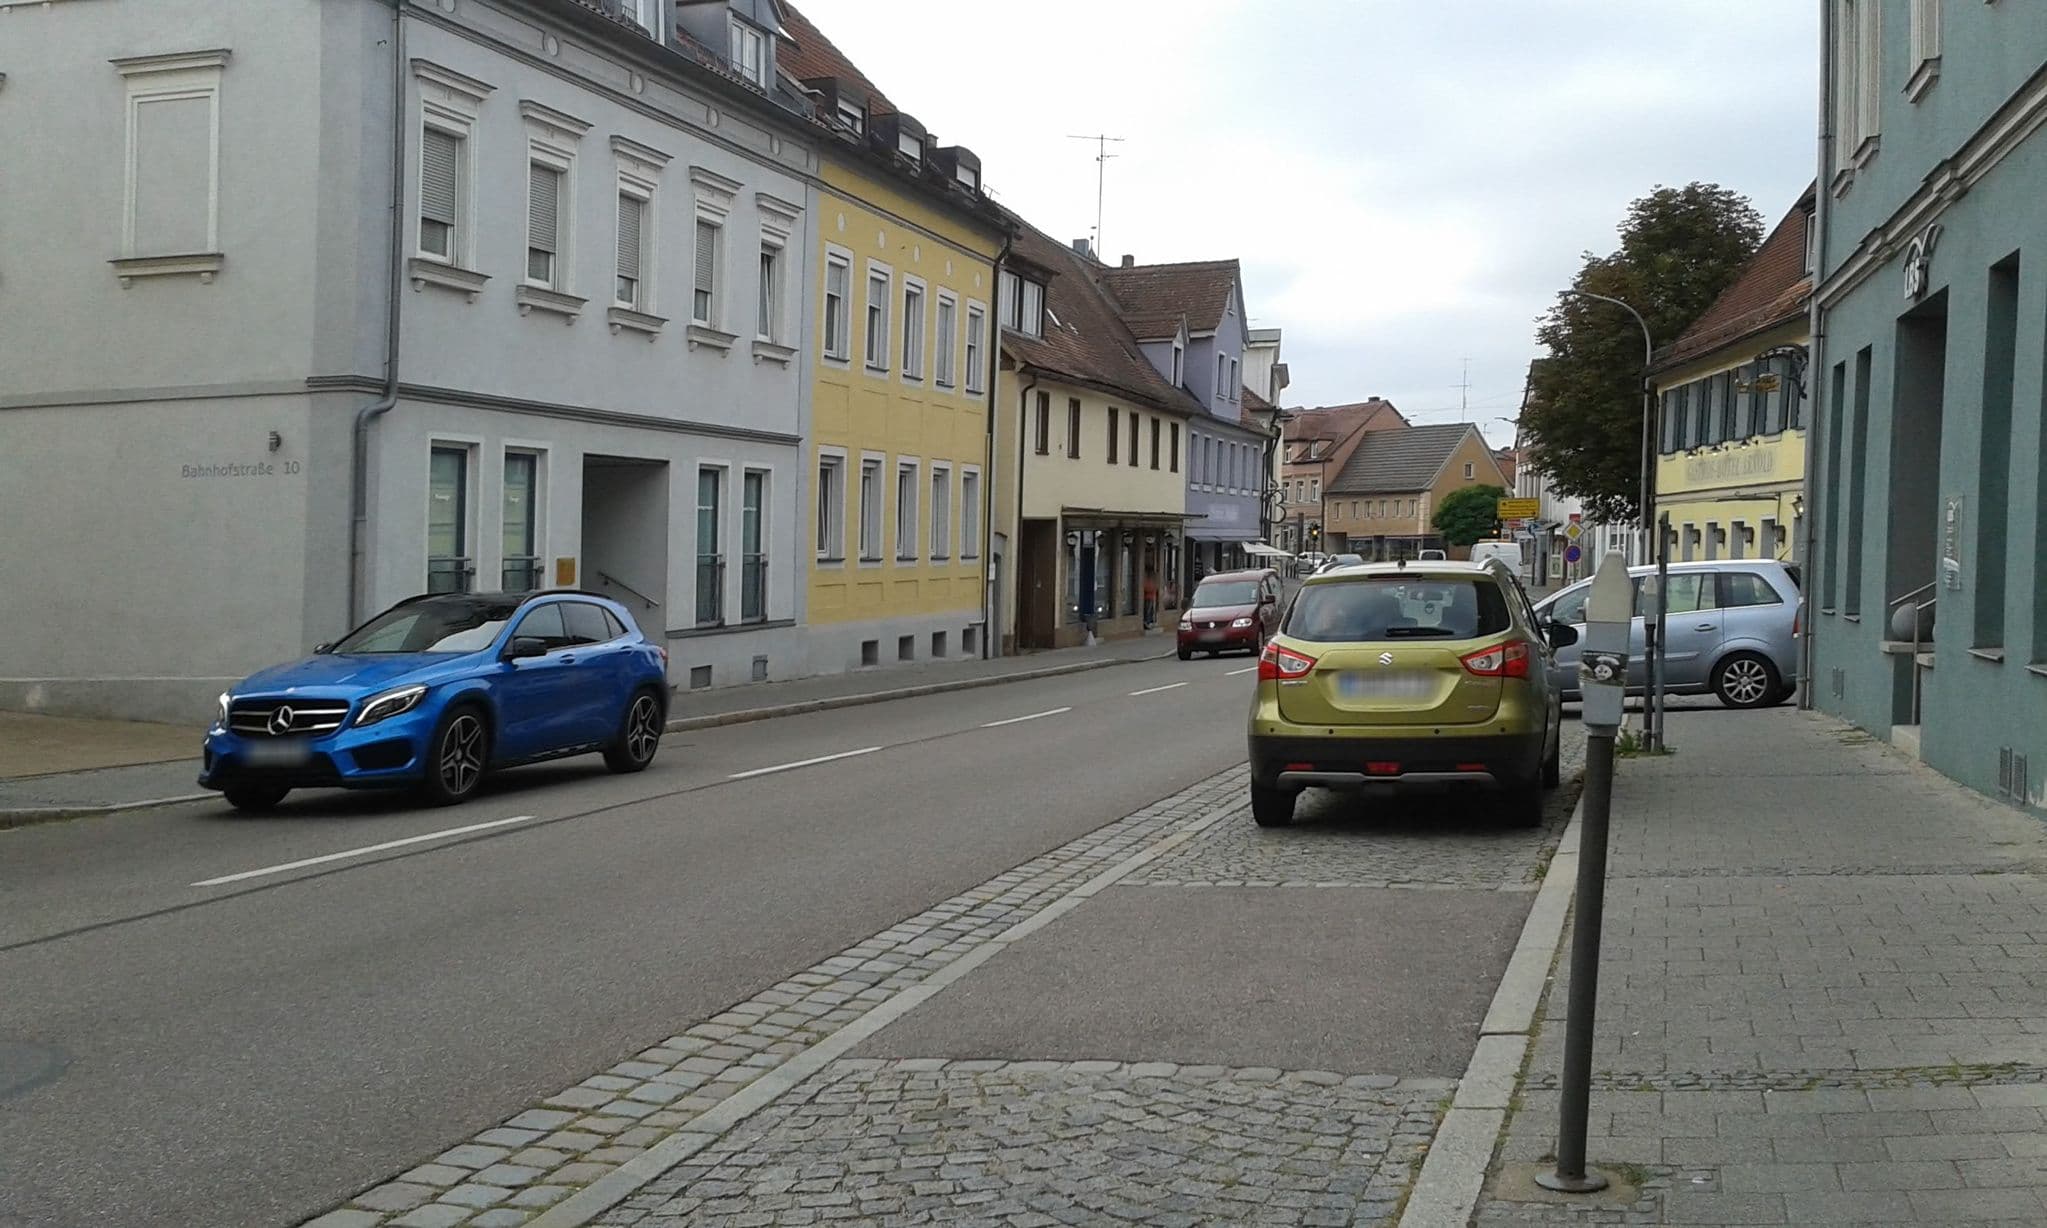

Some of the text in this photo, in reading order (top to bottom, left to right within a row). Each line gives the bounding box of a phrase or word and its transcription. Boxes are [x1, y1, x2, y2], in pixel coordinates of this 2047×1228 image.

[1904, 257, 1920, 299] LBS
[181, 461, 299, 478] Bahnhofstraße 10
